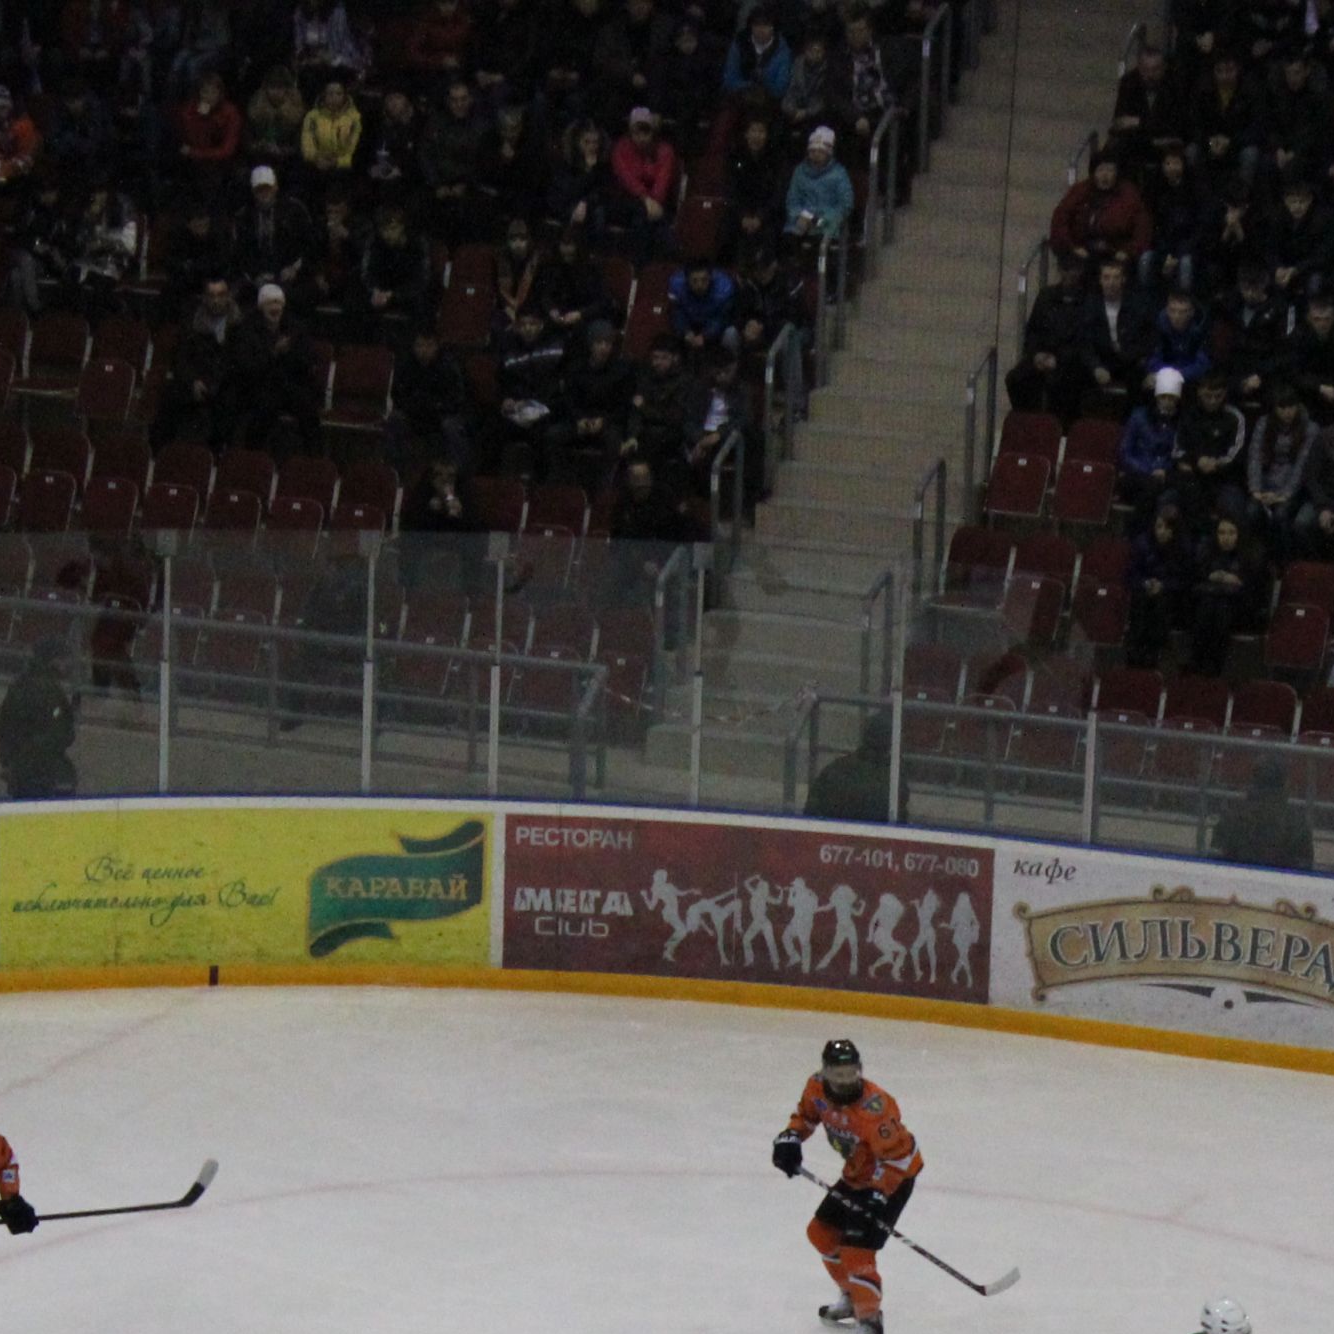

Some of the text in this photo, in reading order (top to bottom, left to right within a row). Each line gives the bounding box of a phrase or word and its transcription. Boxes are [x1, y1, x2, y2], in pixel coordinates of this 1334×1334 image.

[515, 827, 633, 849] РЕСТОРАН
[820, 844, 900, 872] 677-101,
[1012, 857, 1076, 884] кафе
[326, 873, 467, 900] КАРАВАЙ
[534, 915, 609, 938] Club
